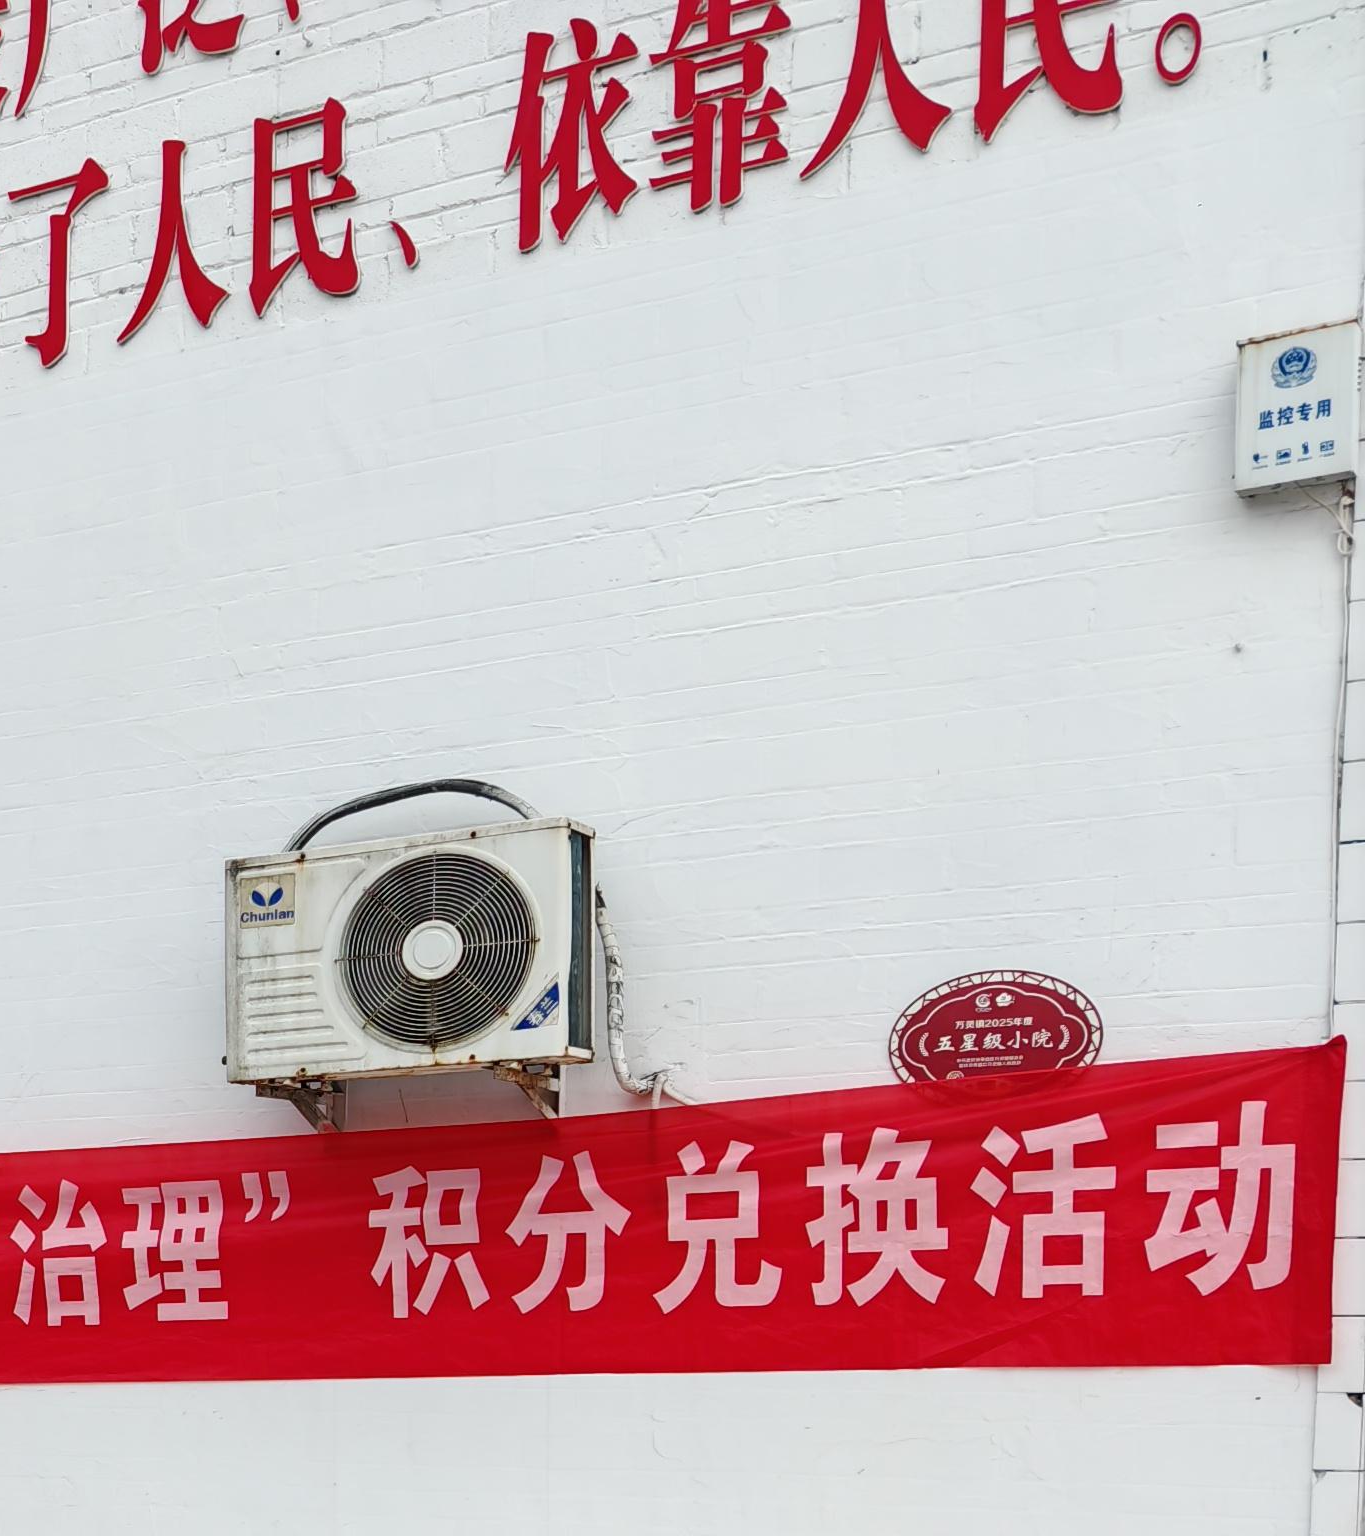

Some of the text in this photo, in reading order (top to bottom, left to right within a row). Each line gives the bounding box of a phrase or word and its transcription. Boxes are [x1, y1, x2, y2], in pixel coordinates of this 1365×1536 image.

[1258, 399, 1332, 431] 监控专用
[240, 909, 295, 923] Chunlan
[933, 1028, 1054, 1053] 五星级小院
